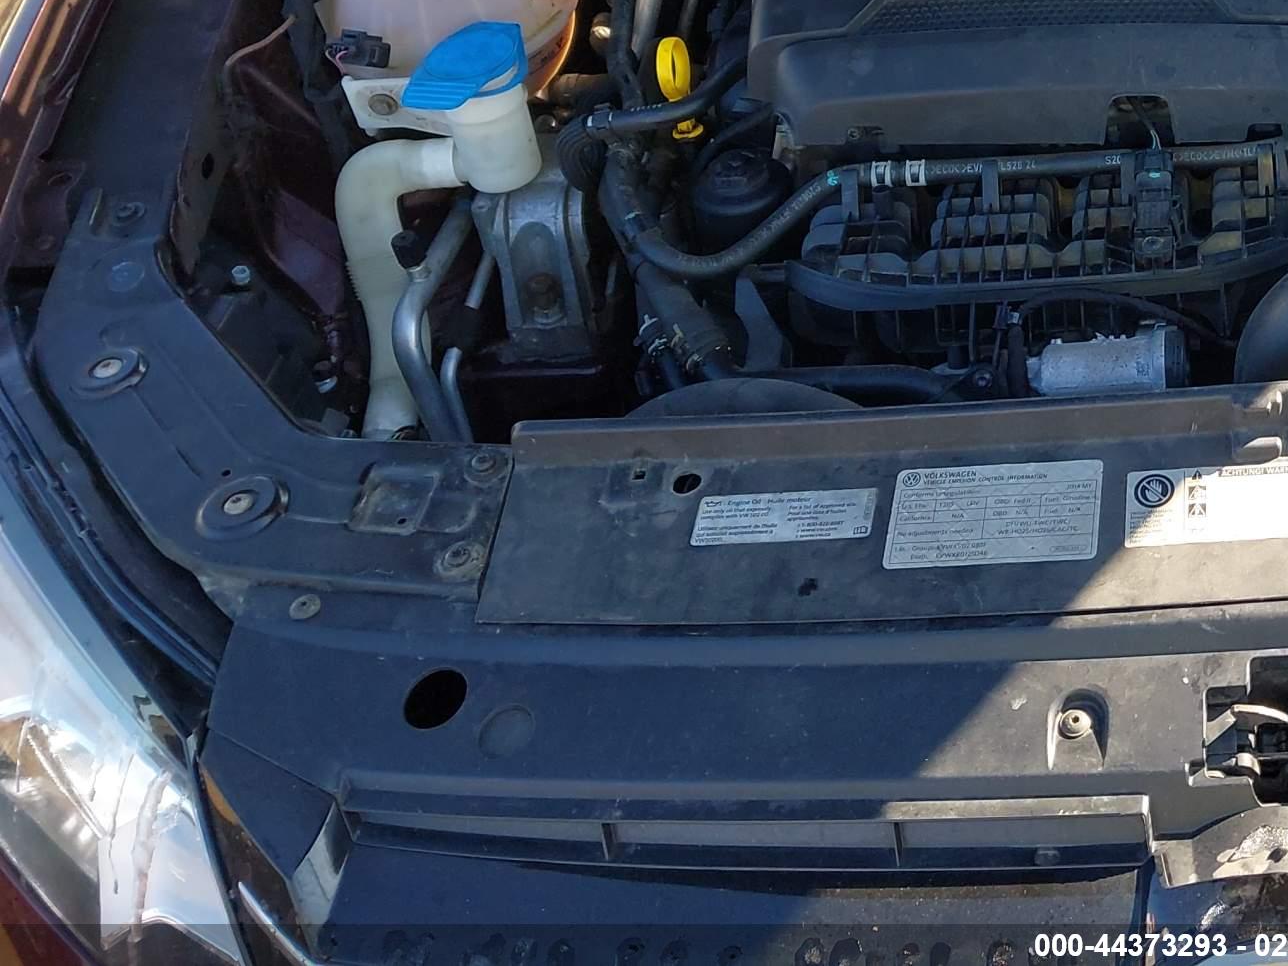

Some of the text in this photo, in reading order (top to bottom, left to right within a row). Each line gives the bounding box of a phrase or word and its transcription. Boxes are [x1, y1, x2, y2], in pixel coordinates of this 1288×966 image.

[924, 470, 977, 481] VOLKSWAGEN
[1222, 467, 1265, 477] ACHTUNG!
[924, 478, 947, 486] VEHICLE
[978, 475, 1005, 483] CONTROL
[1007, 473, 1048, 481] INFORMATION
